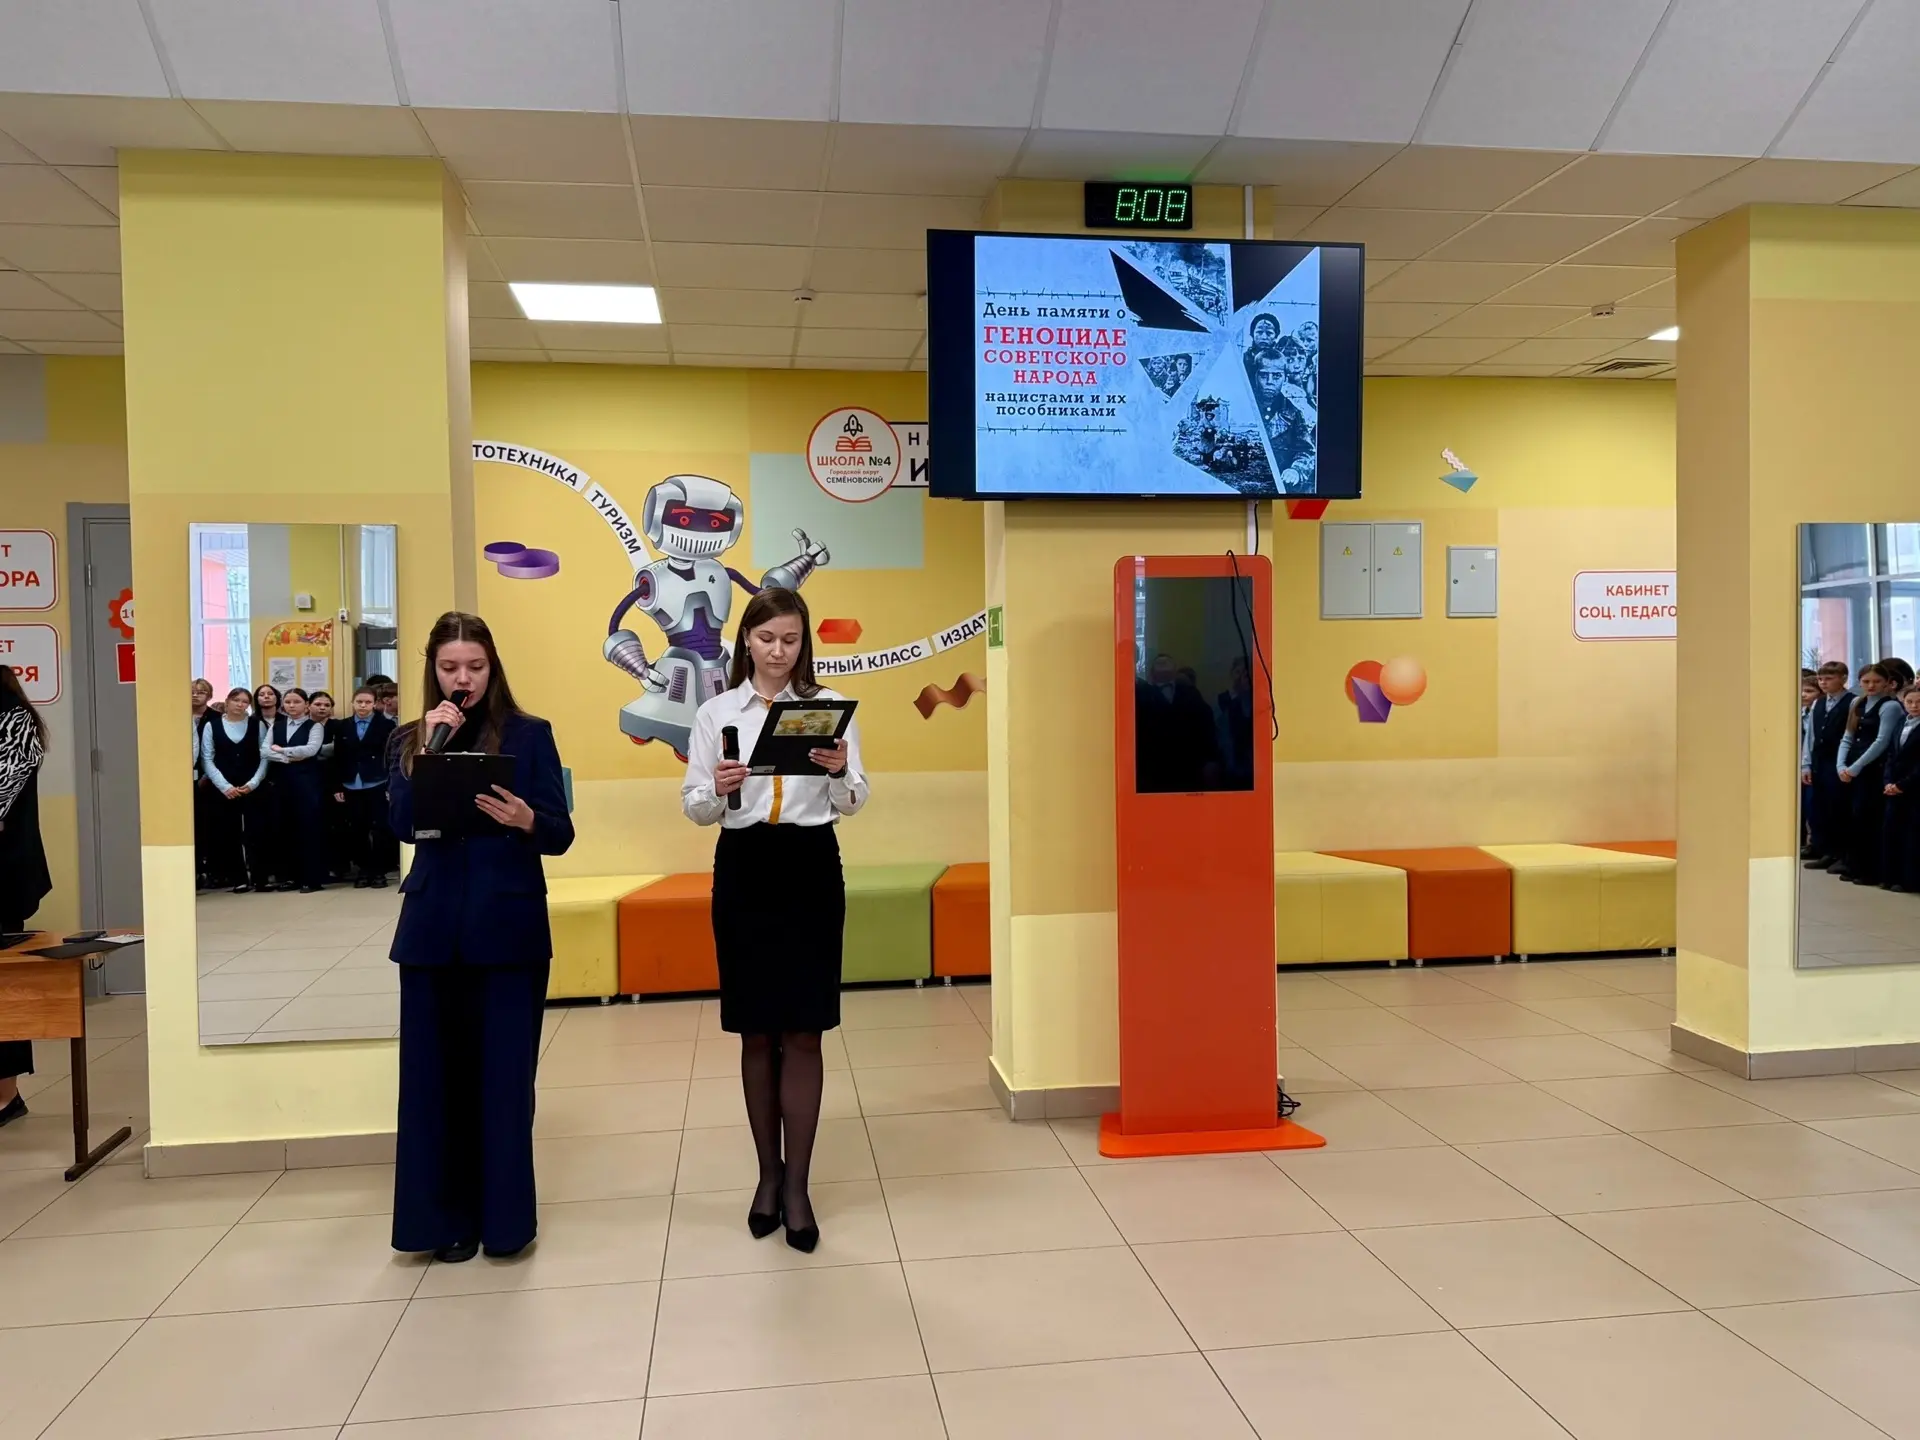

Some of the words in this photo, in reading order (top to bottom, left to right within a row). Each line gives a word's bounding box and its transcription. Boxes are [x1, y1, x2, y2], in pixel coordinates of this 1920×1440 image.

[1115, 189, 1187, 222] 8:08
[983, 303, 1030, 318] День
[1037, 307, 1110, 319] памяти
[1116, 309, 1126, 319] о
[983, 326, 1127, 349] ГЕНОЦИДЕ
[983, 349, 1127, 365] СОВЕТСКОГО
[1013, 369, 1098, 387] НАРОДА
[985, 392, 1084, 404] нацистами
[1090, 395, 1100, 404] и
[1106, 395, 1127, 404] их
[996, 404, 1116, 417] пособниками
[472, 444, 578, 487] ТОТЕХНИКА
[817, 456, 865, 466] ШКОЛА
[868, 456, 891, 466] №4
[826, 475, 884, 484] СЕМЁНОВСКИЙ
[590, 490, 642, 555] ТУРИЗМ
[1606, 585, 1669, 596] КАБИНЕТ
[1579, 606, 1616, 620] СОЦ.
[1621, 606, 1677, 620] ПЕДАГО
[940, 613, 986, 647] ИЗДАТ
[867, 645, 922, 669] КЛАСС
